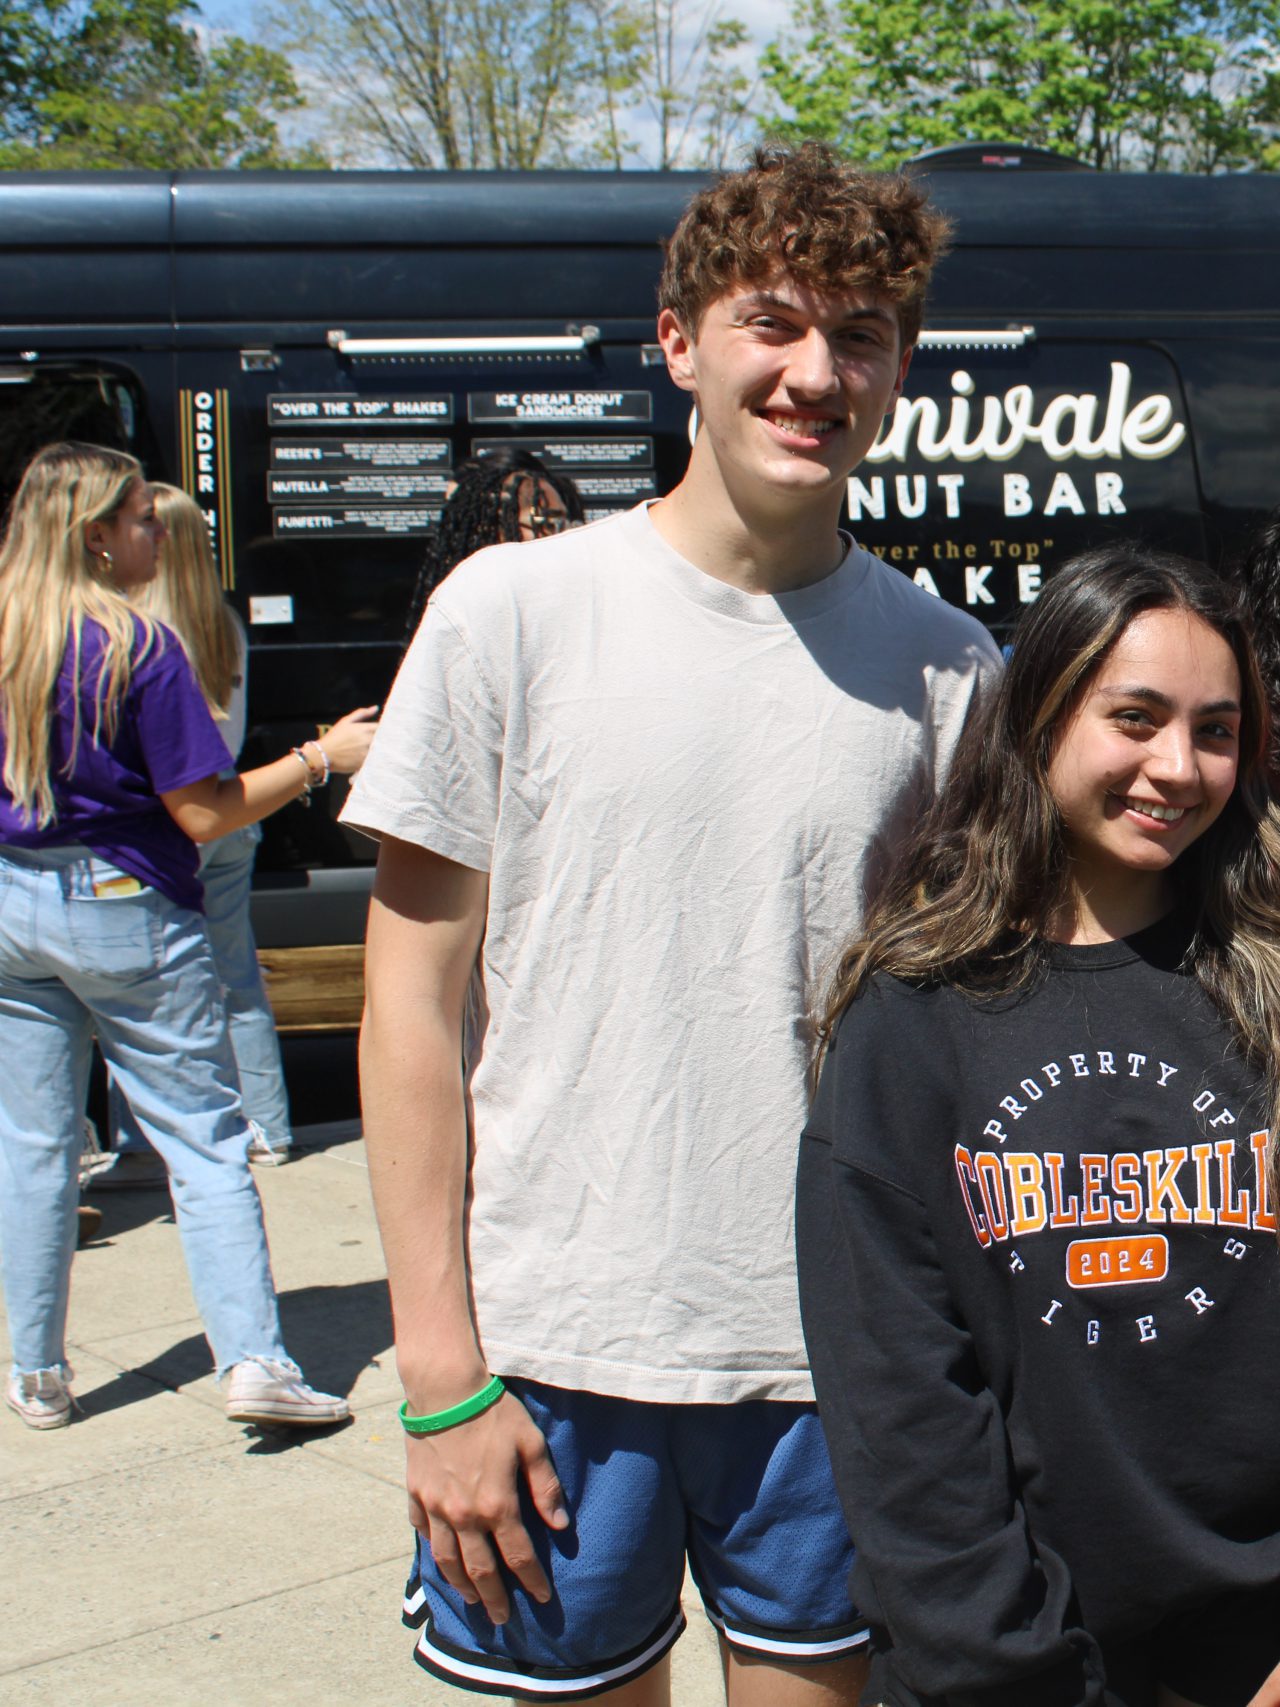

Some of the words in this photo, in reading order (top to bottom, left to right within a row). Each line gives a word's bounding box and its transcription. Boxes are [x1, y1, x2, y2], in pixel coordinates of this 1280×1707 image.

[272, 402, 319, 416] "OVER
[322, 402, 350, 415] THE
[392, 402, 448, 415] SHAKES
[495, 394, 518, 407] ICE
[521, 393, 571, 406] CREAM
[574, 393, 624, 407] DONUT
[515, 405, 605, 418] SANDWICHES
[194, 392, 214, 493] ORDER
[272, 480, 330, 494] NUTELLA
[847, 474, 964, 521] NUT
[1004, 472, 1127, 517] BAR
[277, 515, 334, 529] FUNFETTI
[932, 540, 978, 560] the
[912, 564, 1042, 605] AKE
[983, 1051, 1179, 1144] PROPERTY
[1192, 1090, 1236, 1128] OF
[1080, 1248, 1154, 1277] 2024
[1008, 1237, 1247, 1345] TIGERS
